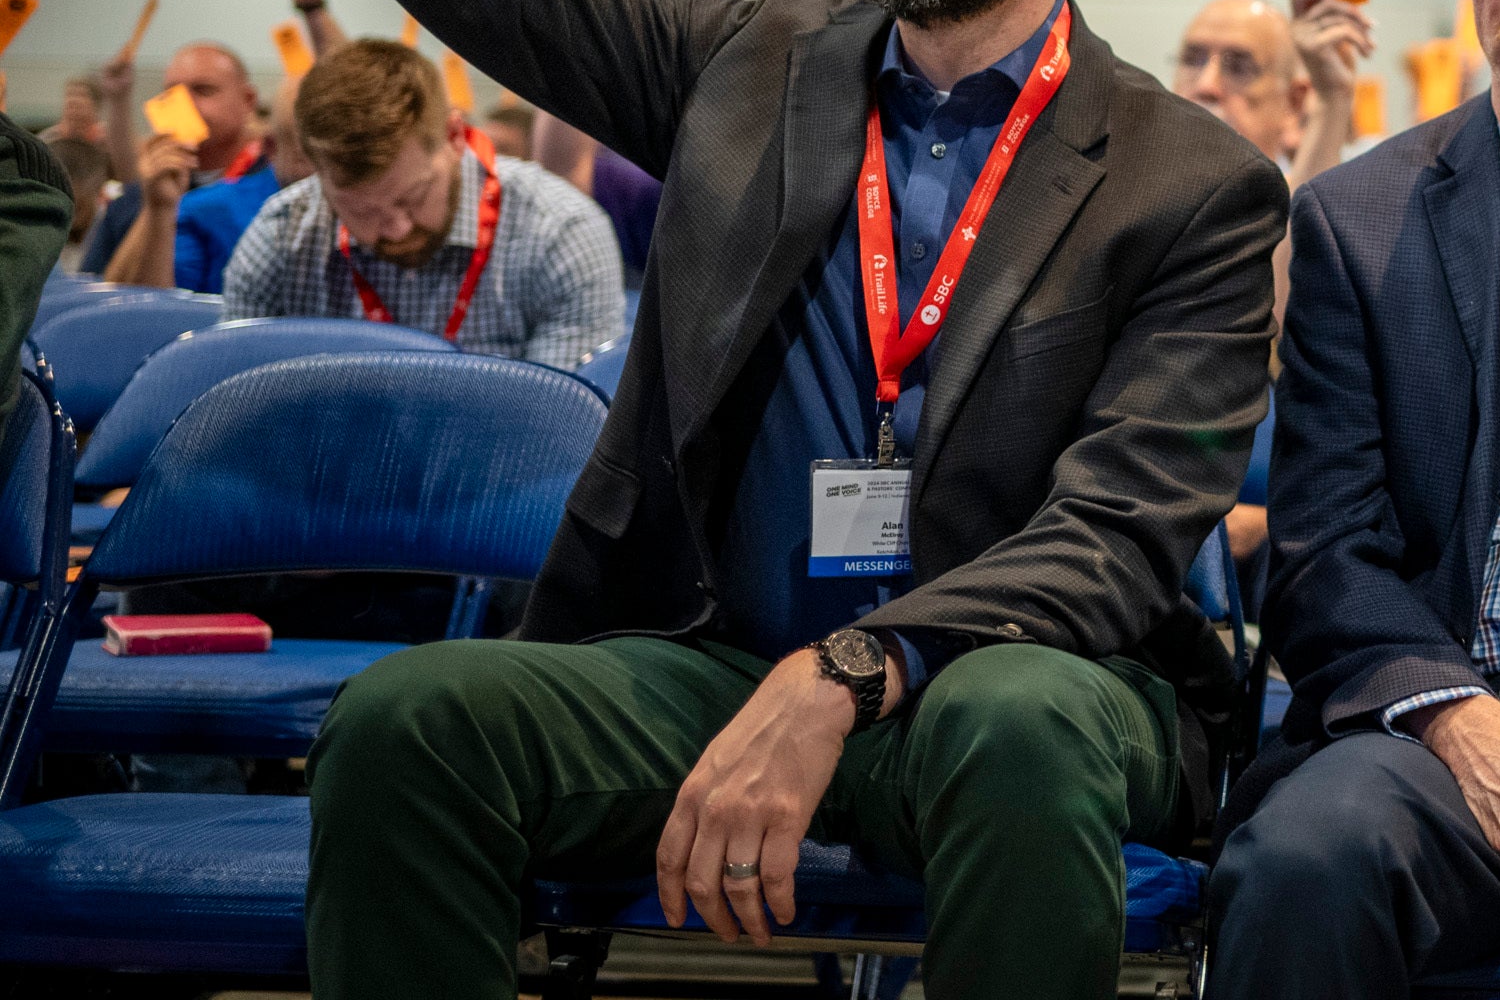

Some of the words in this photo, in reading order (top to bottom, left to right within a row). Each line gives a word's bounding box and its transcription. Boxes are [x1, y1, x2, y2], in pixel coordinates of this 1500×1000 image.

[875, 271, 886, 294] Trail
[934, 275, 954, 304] SBC
[877, 296, 887, 314] Life
[842, 488, 861, 496] VOICE
[881, 522, 904, 530] Alan
[845, 560, 912, 571] MESSENGE
